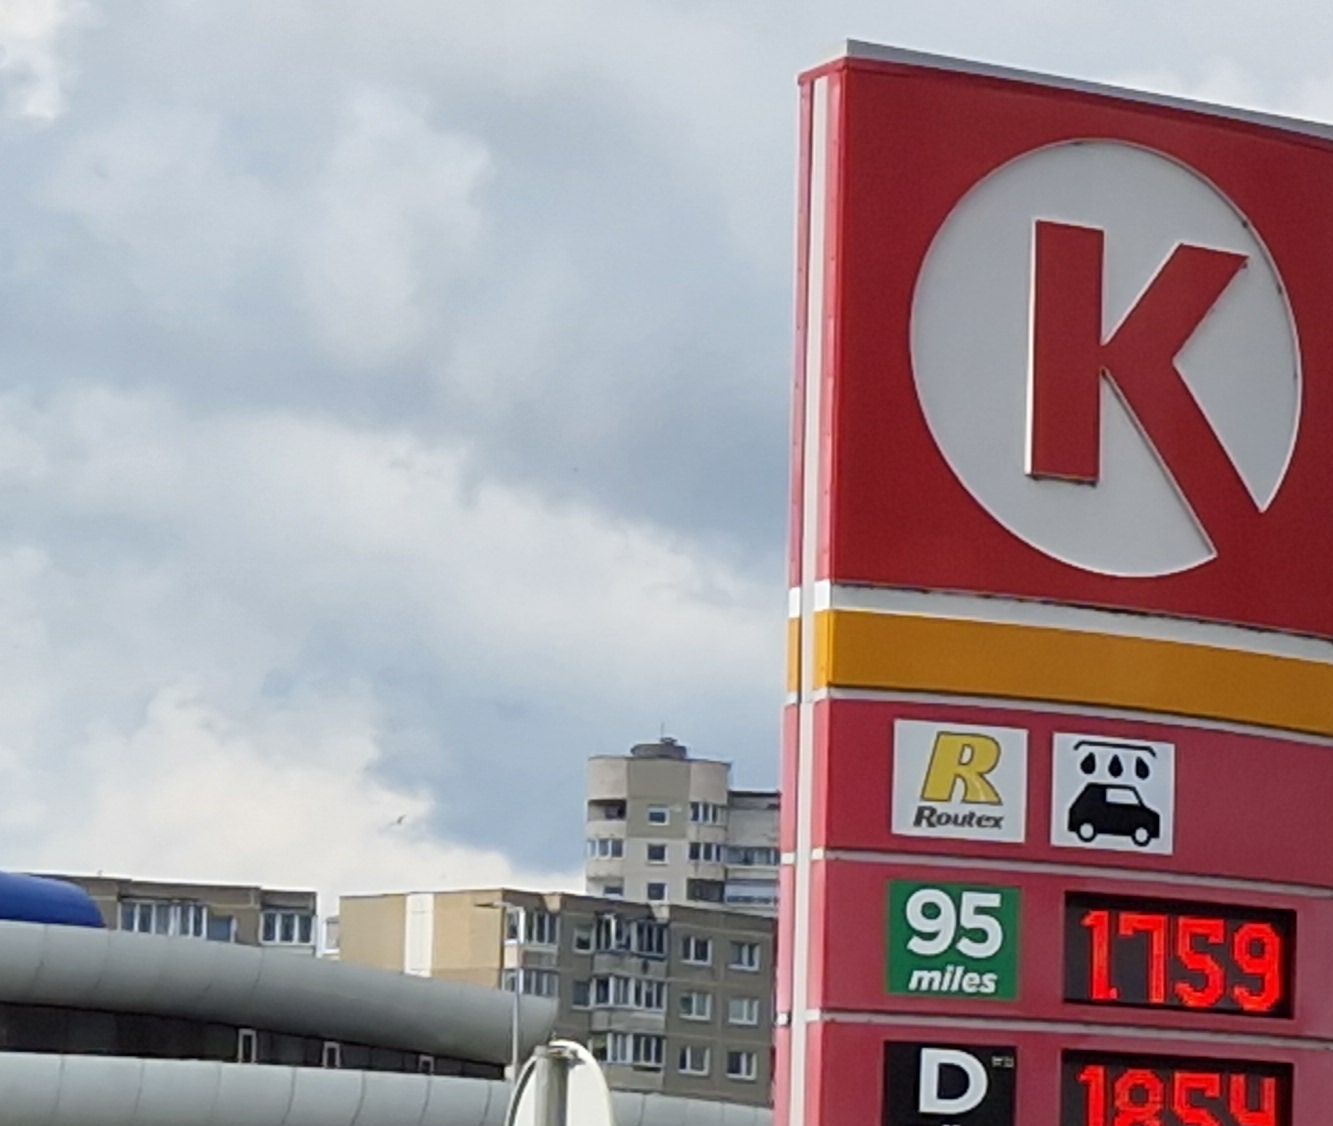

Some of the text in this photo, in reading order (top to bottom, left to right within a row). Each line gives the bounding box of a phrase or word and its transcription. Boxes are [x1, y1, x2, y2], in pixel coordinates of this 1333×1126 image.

[1030, 217, 1263, 558] K
[911, 804, 1005, 831] Routex
[904, 888, 1004, 958] 95
[907, 965, 998, 994] miles
[917, 1047, 989, 1116] D
